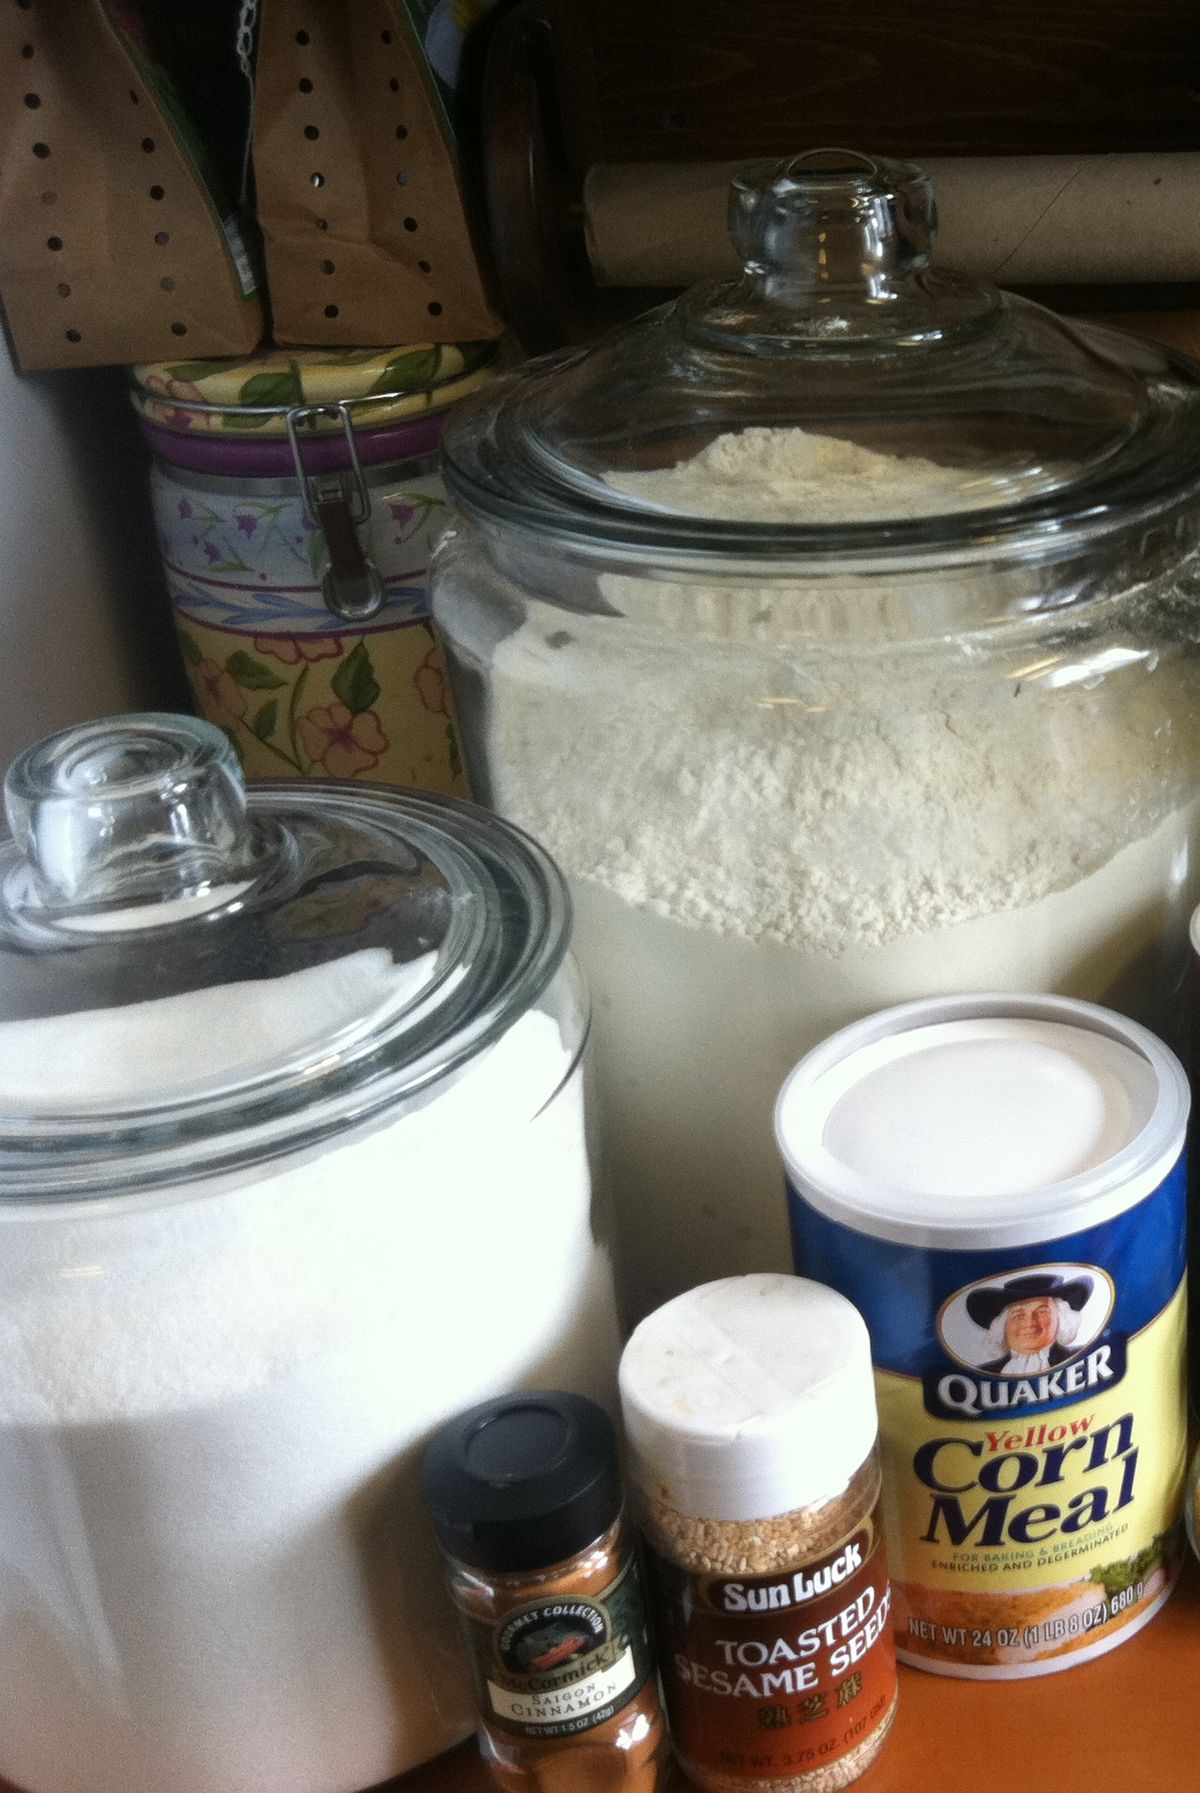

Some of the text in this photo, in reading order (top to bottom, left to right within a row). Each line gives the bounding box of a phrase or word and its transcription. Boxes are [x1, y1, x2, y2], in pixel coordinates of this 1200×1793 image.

[937, 1343, 1114, 1415] QUAKER
[912, 1413, 1136, 1495] Corn
[984, 1413, 1098, 1454] Yellow
[920, 1445, 1139, 1549] Meal
[931, 1522, 1129, 1574] ENRICHED AND DEGERMINATED
[952, 1521, 1115, 1564] FOR BAKING & BREADING
[723, 1541, 863, 1612] Sun Luck
[500, 1604, 605, 1651] GOURMET COLLECTION
[715, 1585, 875, 1667] TOASTED
[908, 1581, 1146, 1650] NET WT 24 OZ (1 LB 8 OZ) 680 g
[531, 1682, 596, 1705] SAIGON
[674, 1651, 819, 1698] SESAME
[510, 1682, 617, 1717] CINNAMON
[525, 1705, 615, 1737] NET WT 1.5 OZ (42g)
